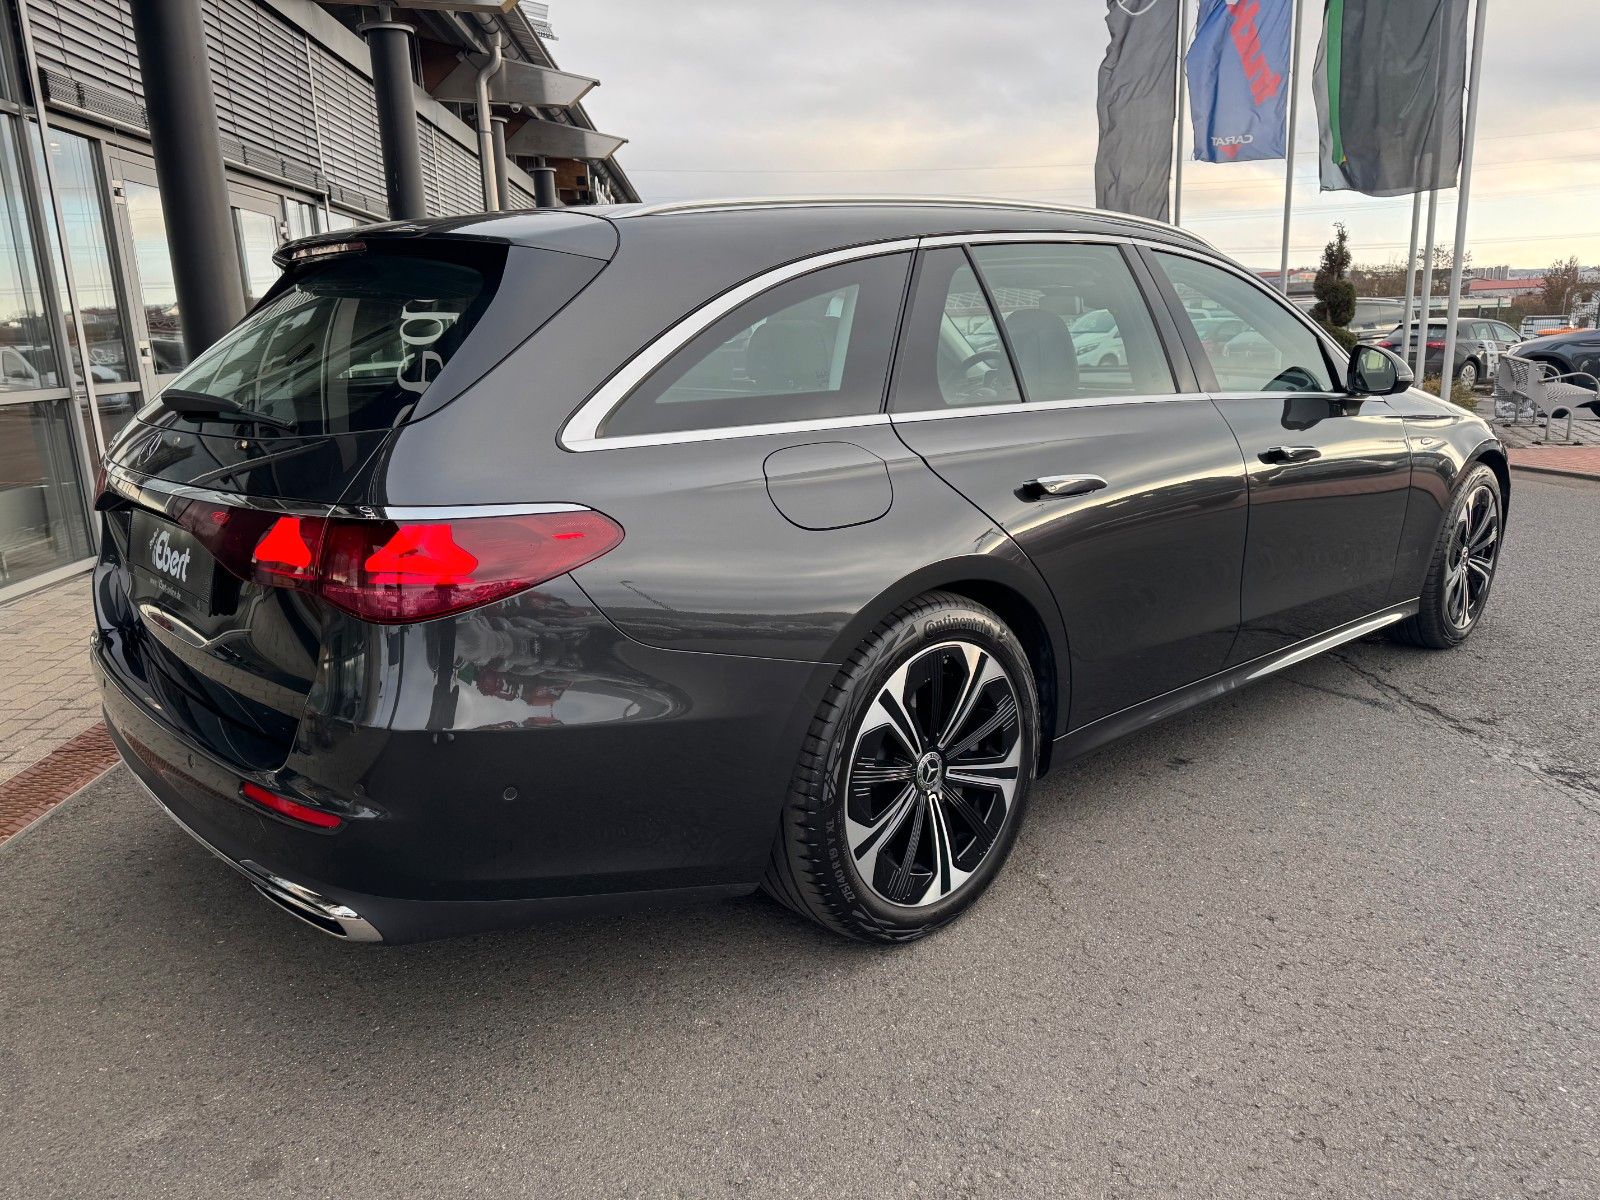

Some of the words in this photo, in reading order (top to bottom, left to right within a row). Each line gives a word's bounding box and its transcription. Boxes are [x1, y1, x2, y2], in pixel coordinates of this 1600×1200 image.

[156, 530, 191, 583] Ebert
[924, 614, 989, 639] Continental
[834, 869, 856, 903] 275/40
